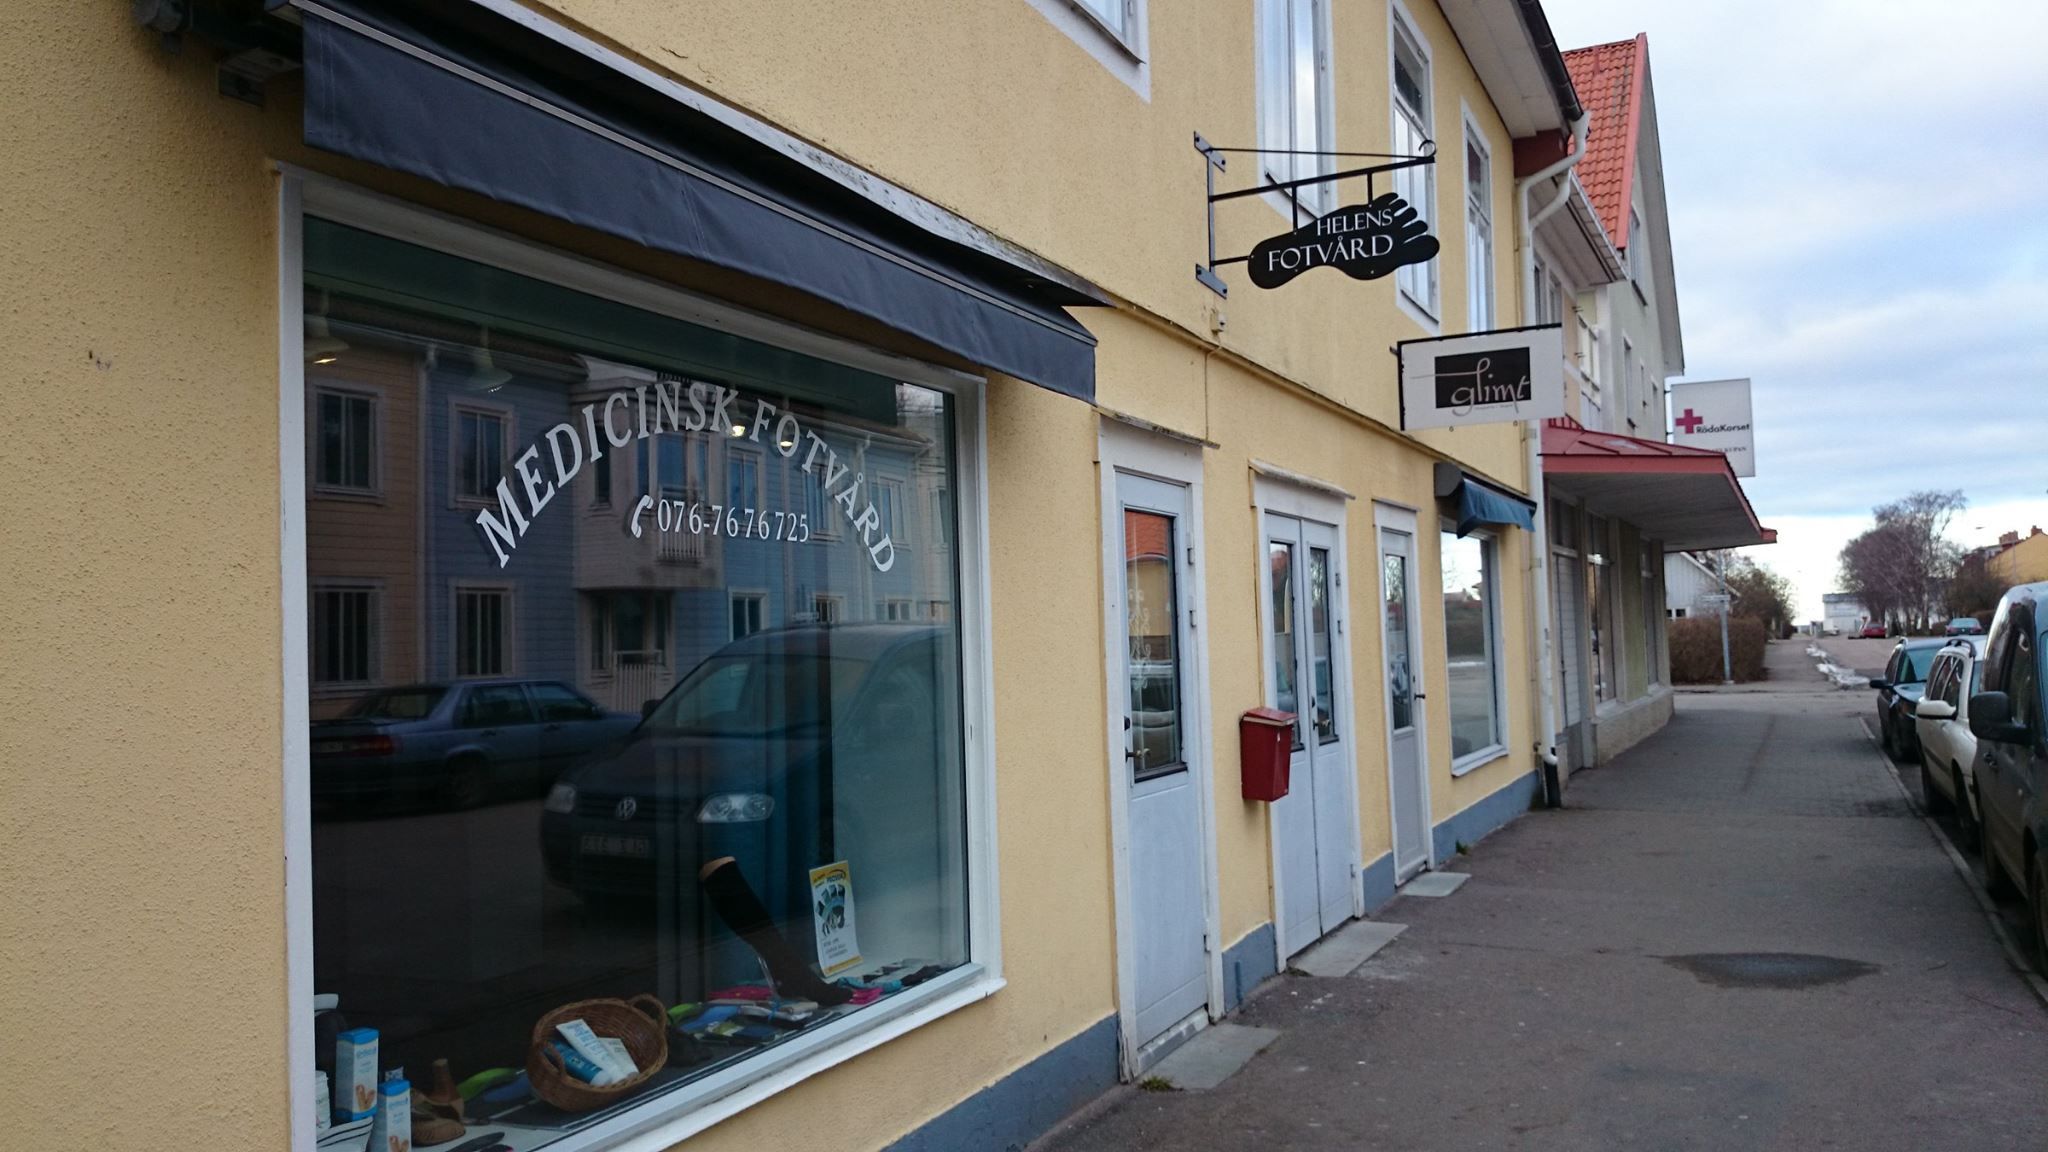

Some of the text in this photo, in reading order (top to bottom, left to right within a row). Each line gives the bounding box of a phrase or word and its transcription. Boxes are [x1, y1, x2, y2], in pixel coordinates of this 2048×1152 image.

[1316, 208, 1393, 236] HELENS
[1268, 234, 1393, 271] FOTVÅRD
[1430, 357, 1531, 416] glimt
[475, 381, 896, 573] MEDICINSK FOTVÅRD
